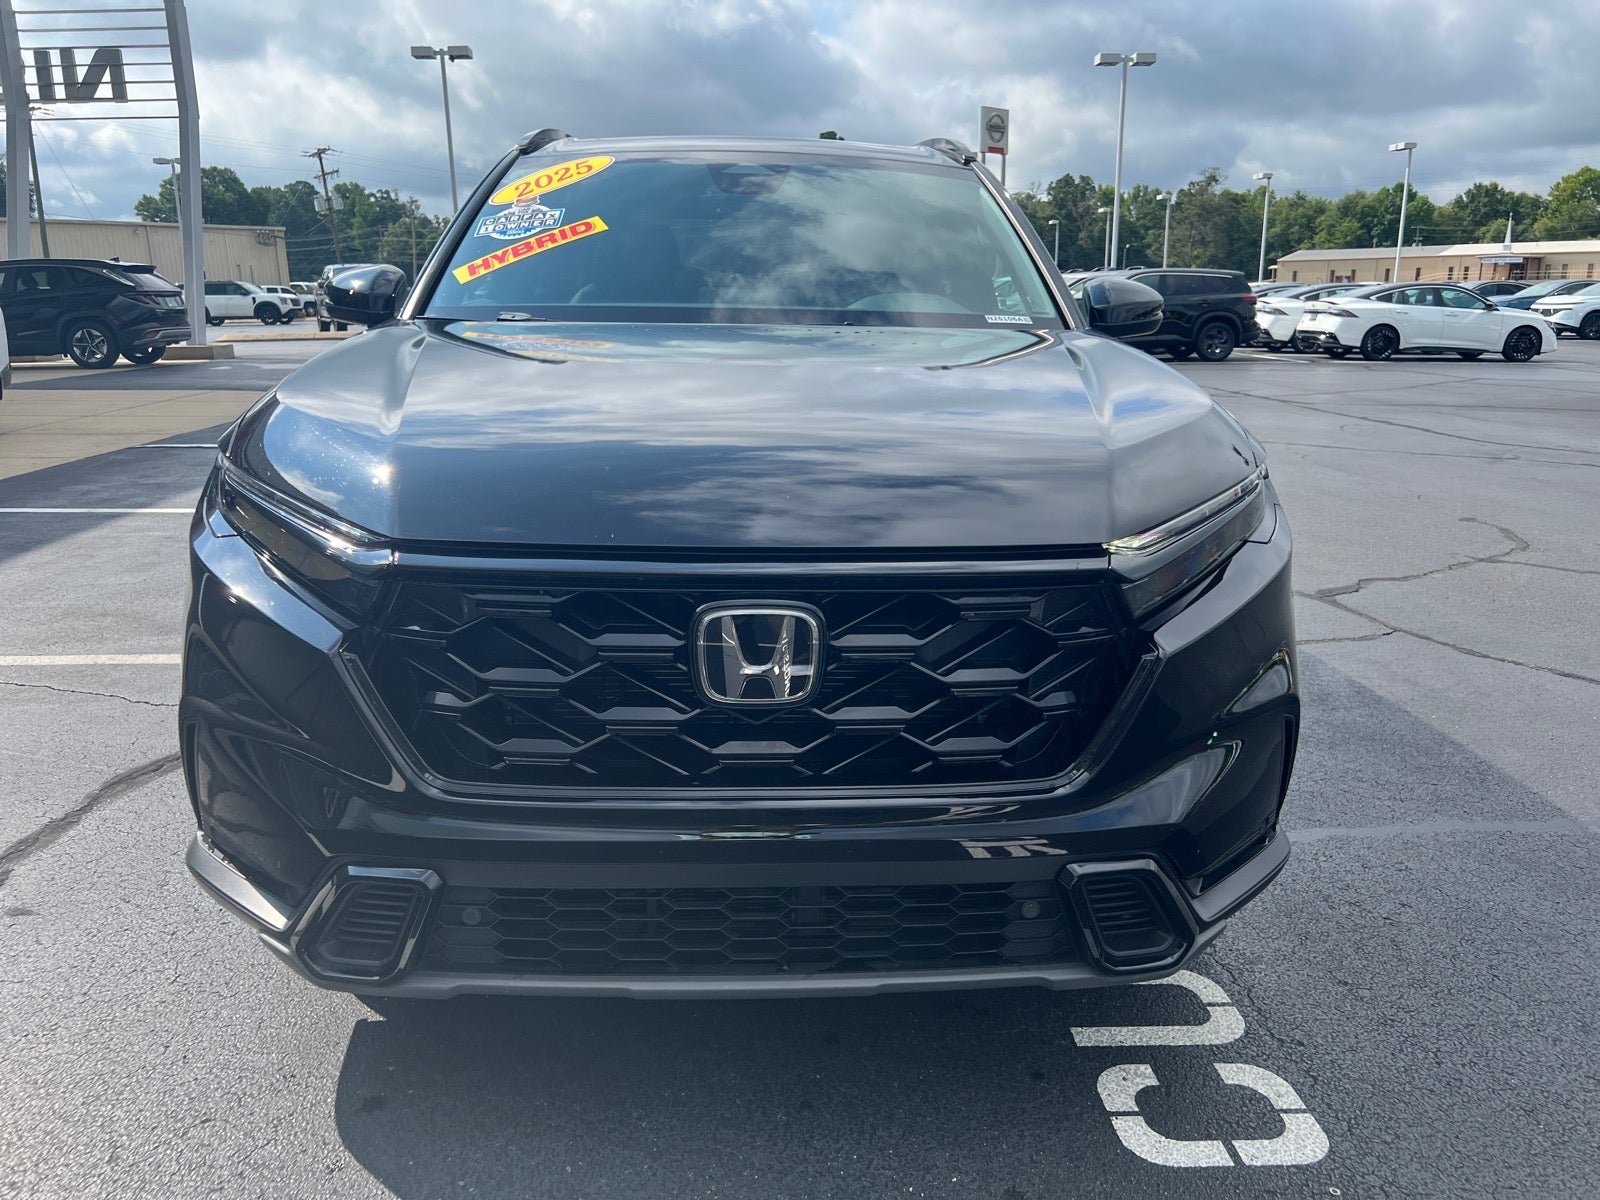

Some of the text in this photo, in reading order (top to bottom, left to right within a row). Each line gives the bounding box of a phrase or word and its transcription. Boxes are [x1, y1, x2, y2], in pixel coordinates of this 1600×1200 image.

[514, 160, 593, 198] 2025
[485, 212, 558, 225] CARFAX
[494, 219, 555, 231] OWNER
[467, 221, 597, 277] HYBRID
